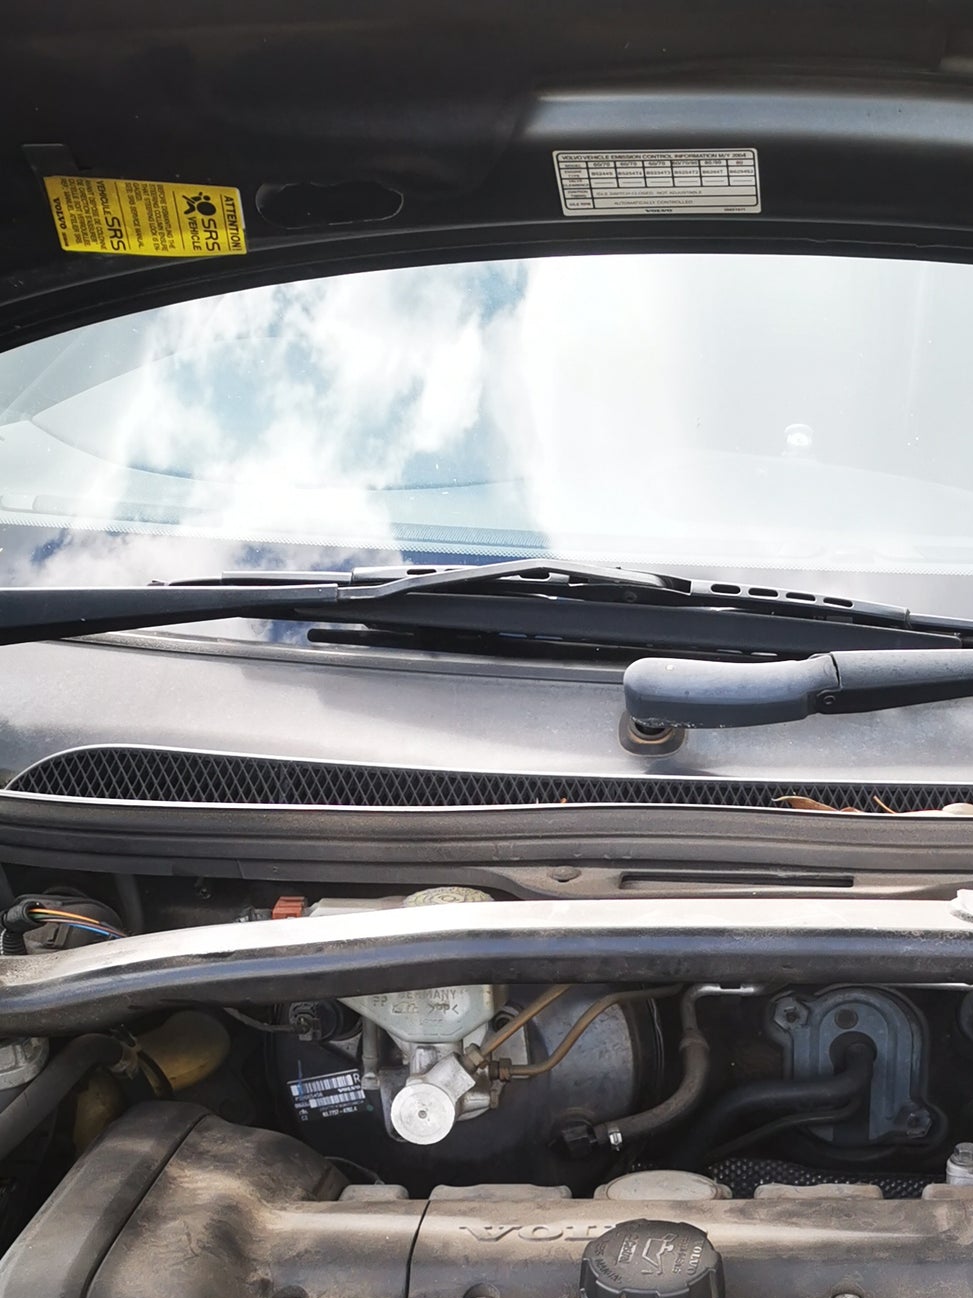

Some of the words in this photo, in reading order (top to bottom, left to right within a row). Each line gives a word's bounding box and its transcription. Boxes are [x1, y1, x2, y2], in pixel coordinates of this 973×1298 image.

[53, 198, 67, 230] VOLVO
[105, 217, 126, 251] SRS
[188, 217, 202, 250] VEHICLE
[201, 218, 220, 251] SRS
[459, 1223, 615, 1242] VOL
